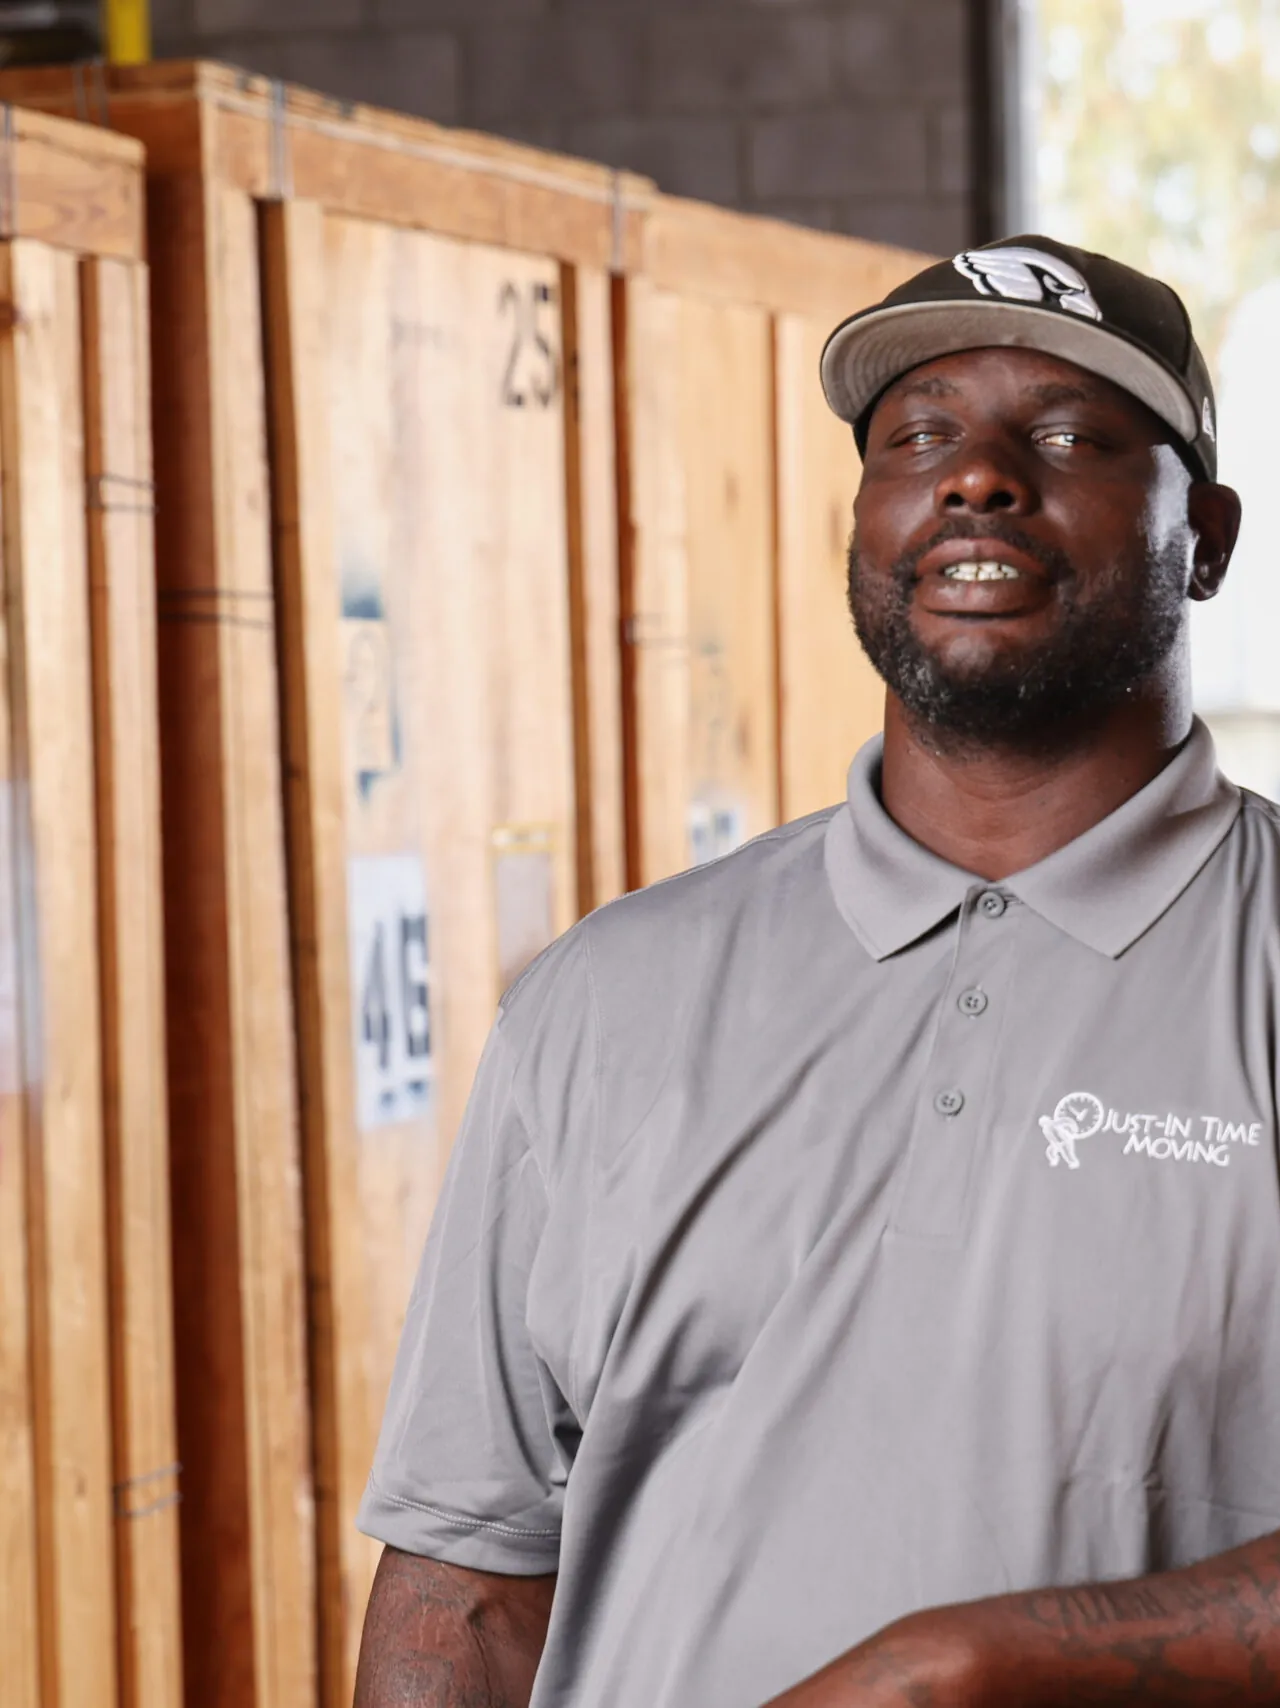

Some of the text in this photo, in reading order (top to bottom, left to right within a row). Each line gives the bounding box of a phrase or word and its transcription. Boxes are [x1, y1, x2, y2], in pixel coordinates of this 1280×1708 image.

[498, 279, 561, 408] 25
[1102, 1108, 1262, 1146] JUST-IN TIME
[1122, 1134, 1230, 1167] MOVING
